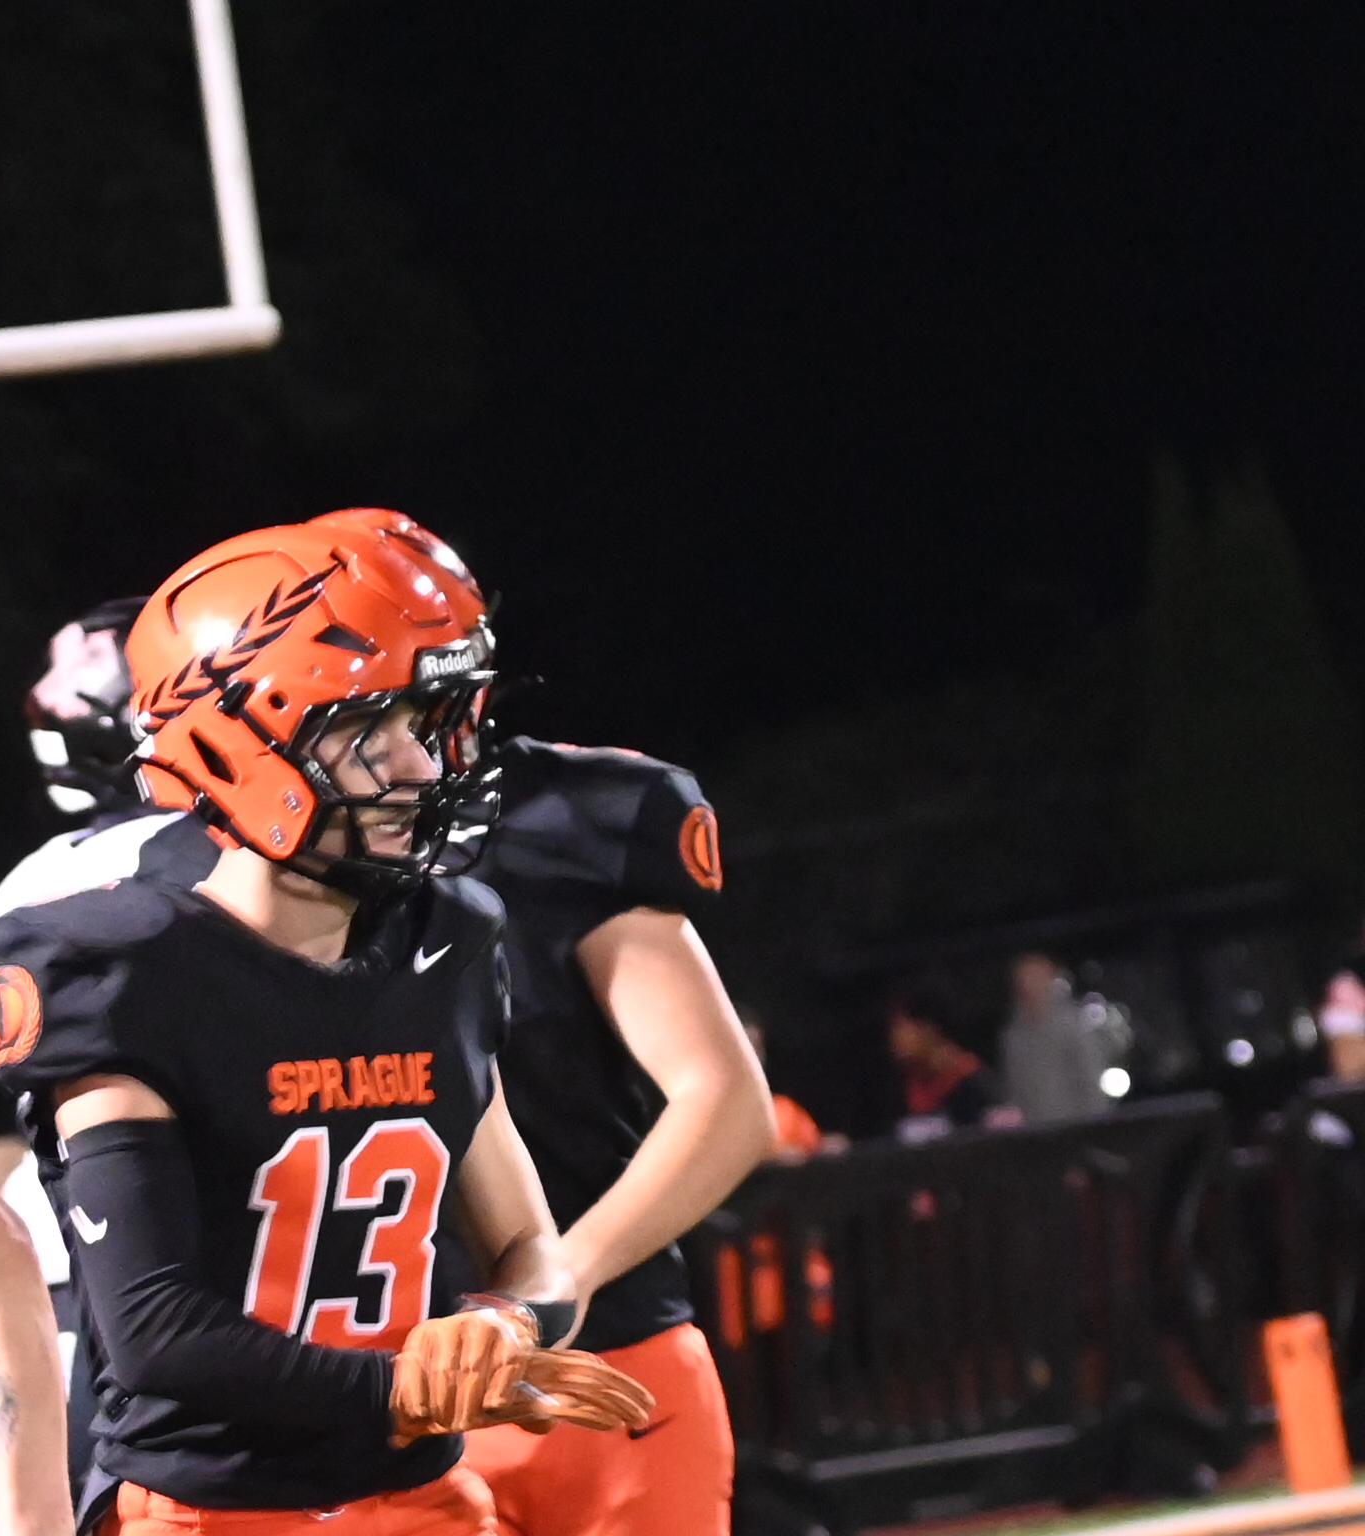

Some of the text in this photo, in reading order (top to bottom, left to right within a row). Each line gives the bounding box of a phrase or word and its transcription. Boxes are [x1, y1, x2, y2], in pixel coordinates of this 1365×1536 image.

[421, 650, 475, 677] Riddell
[267, 1052, 436, 1114] SPRAGUE
[243, 1117, 451, 1353] 13
